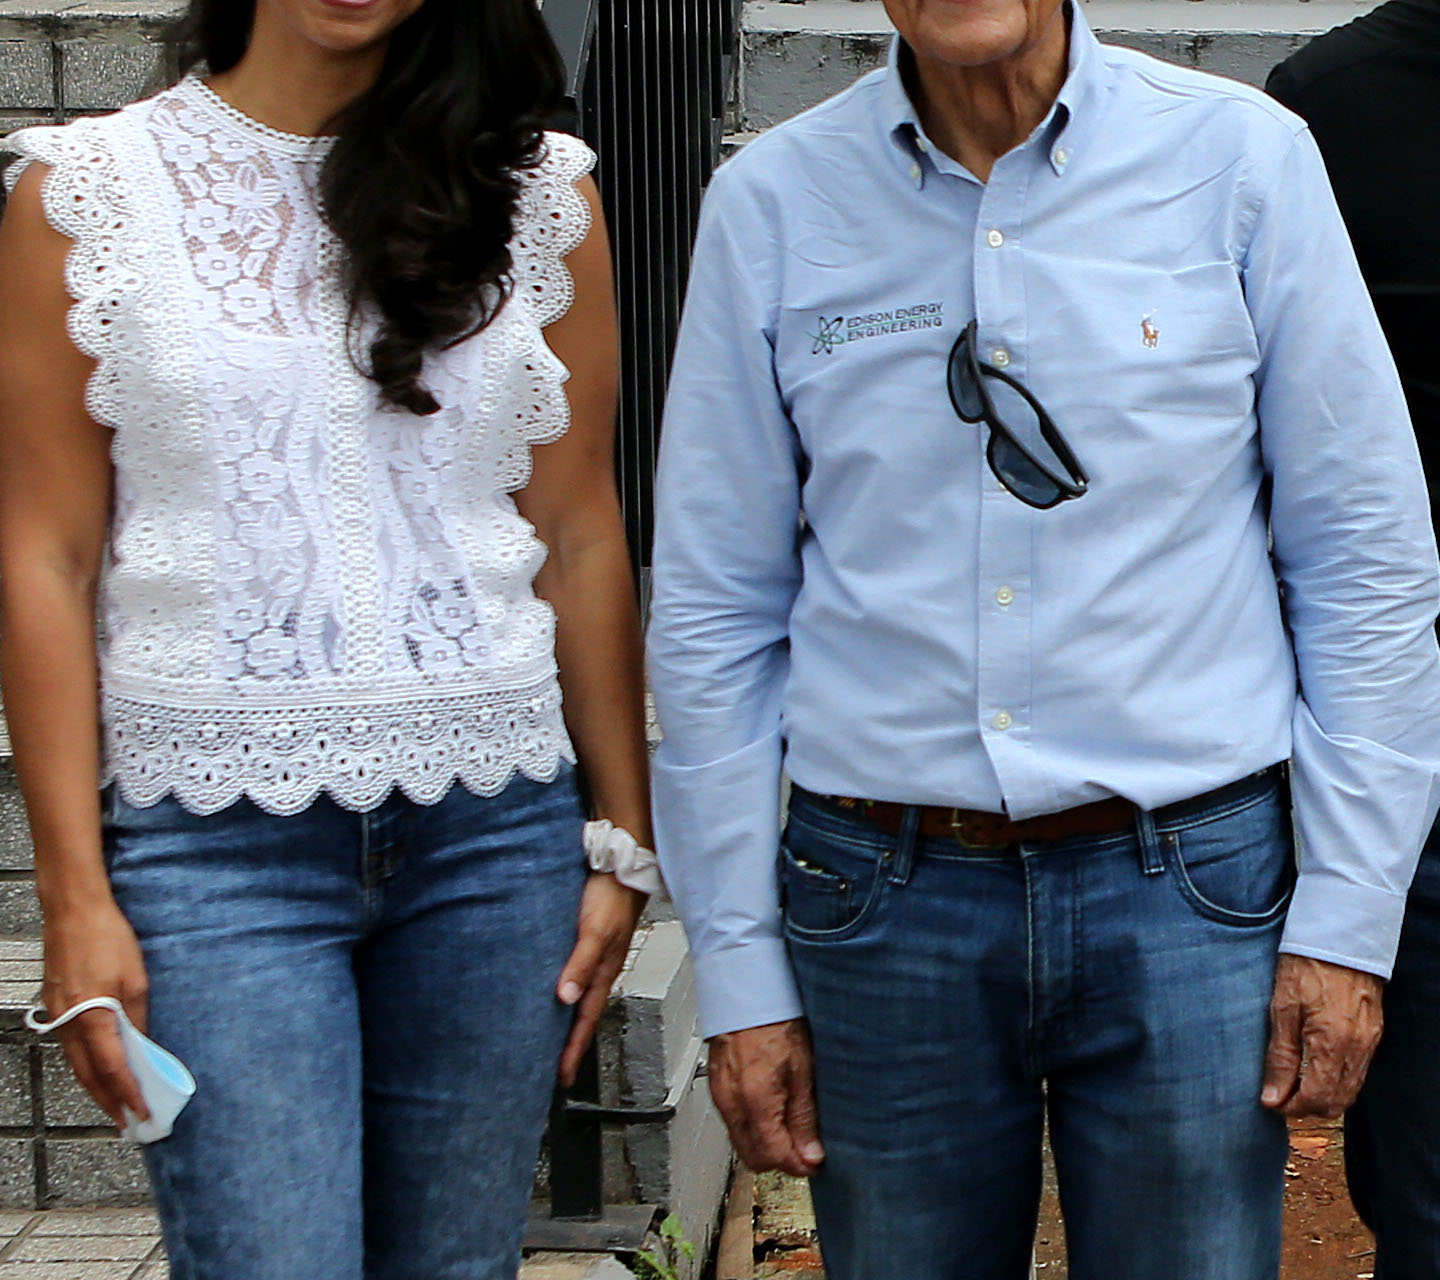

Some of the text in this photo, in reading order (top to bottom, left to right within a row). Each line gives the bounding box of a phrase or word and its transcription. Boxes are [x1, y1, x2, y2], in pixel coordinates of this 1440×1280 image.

[847, 303, 943, 328] EDISON ENERGY
[847, 318, 942, 341] ENGINEERING
